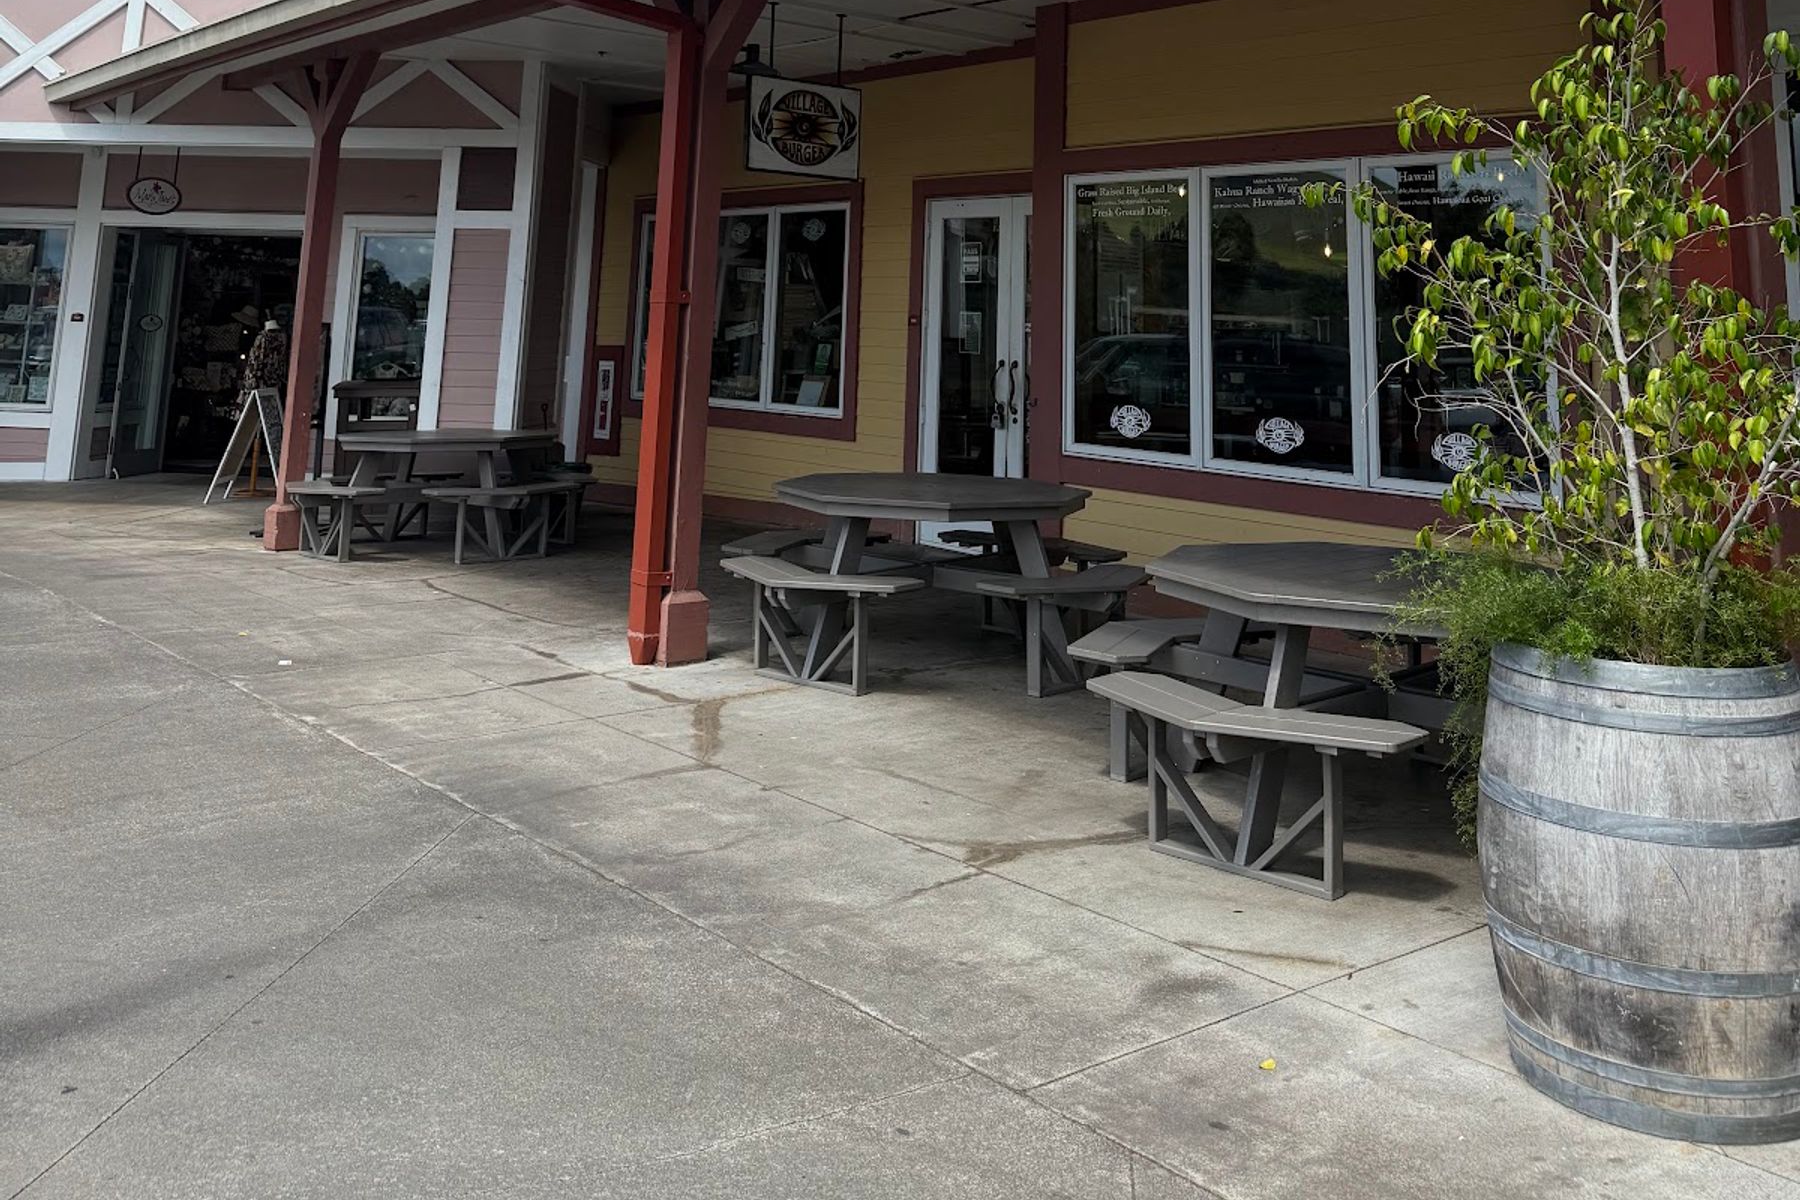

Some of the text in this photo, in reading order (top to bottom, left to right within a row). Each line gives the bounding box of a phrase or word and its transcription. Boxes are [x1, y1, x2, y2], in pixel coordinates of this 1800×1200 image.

[783, 93, 830, 115] VILLAGE
[782, 141, 825, 163] BURGER
[1398, 170, 1436, 182] Hawaii
[1099, 186, 1125, 197] Raised
[1126, 185, 1140, 197] Big
[1141, 184, 1165, 195] Island
[1245, 184, 1275, 196] Ranch
[1115, 206, 1145, 217] Ground
